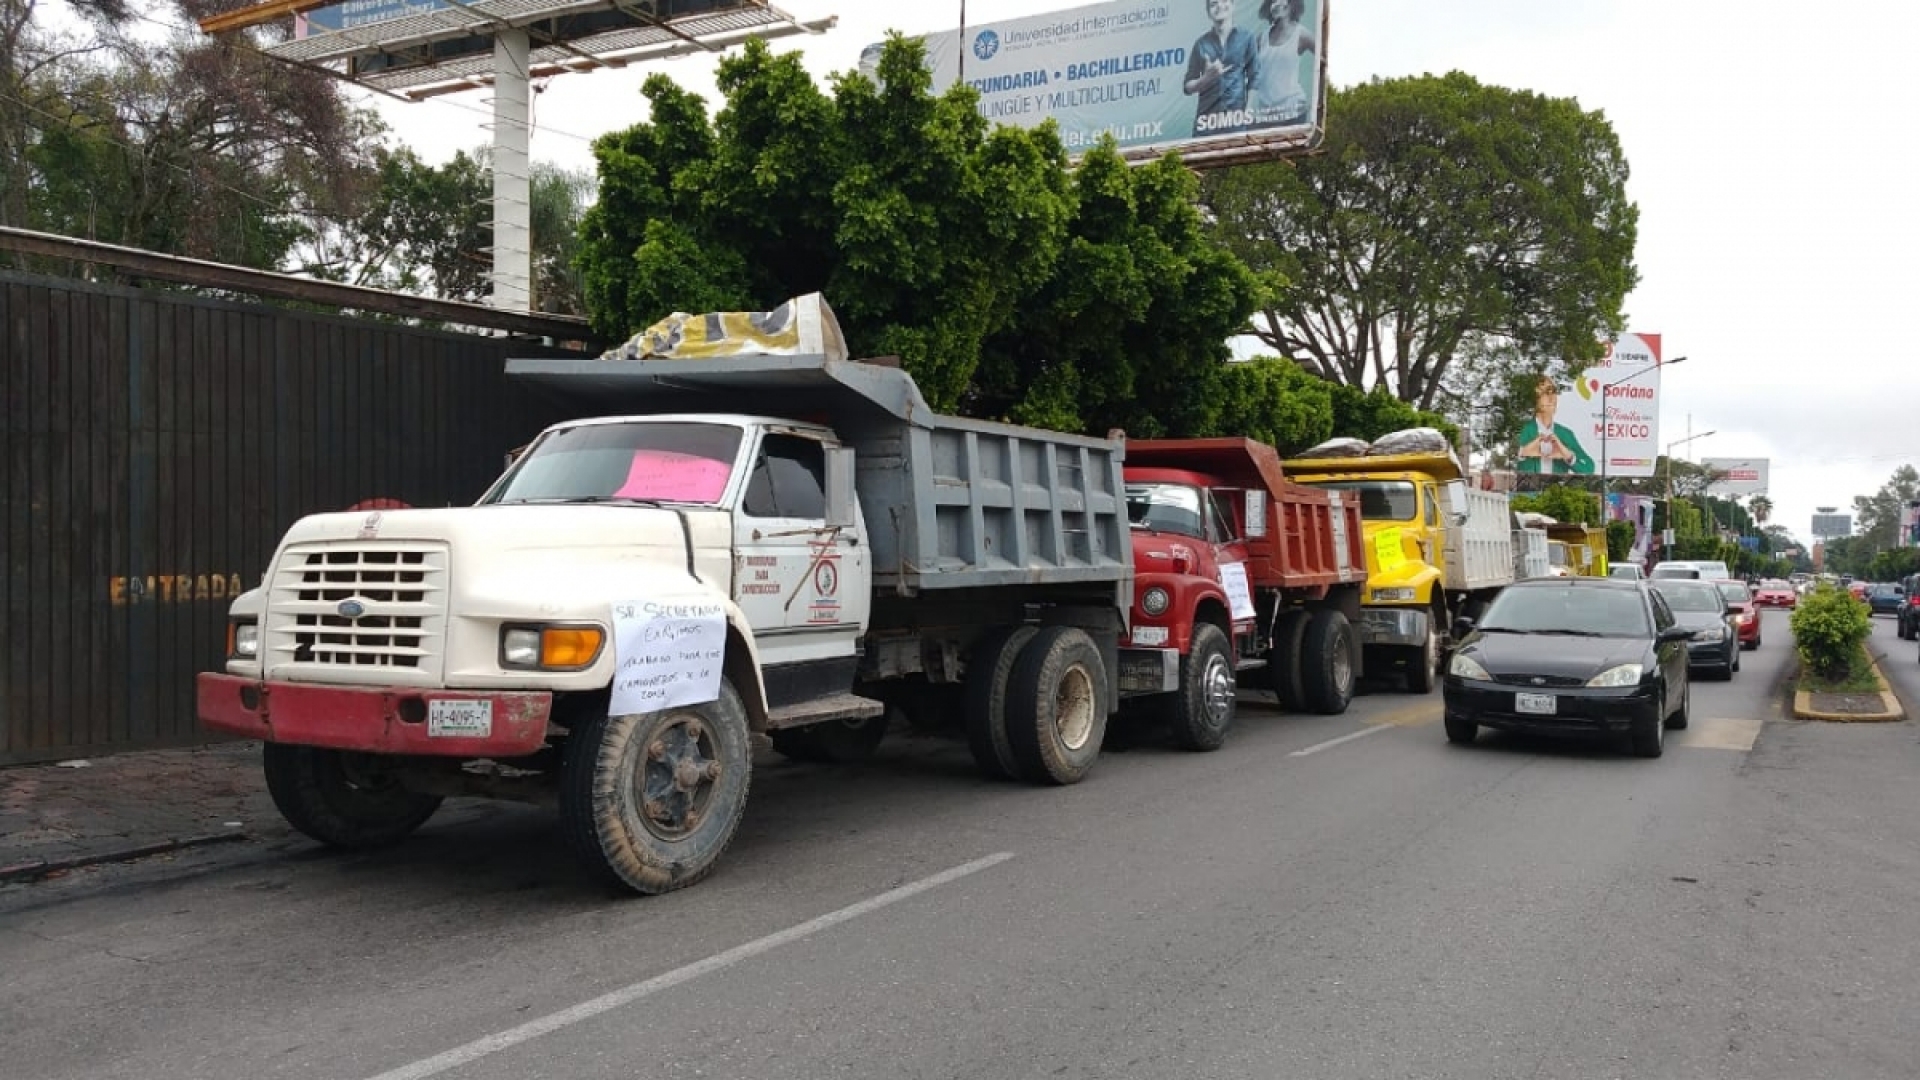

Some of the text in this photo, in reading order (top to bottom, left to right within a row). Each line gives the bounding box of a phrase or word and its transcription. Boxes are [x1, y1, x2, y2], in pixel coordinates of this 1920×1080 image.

[1004, 19, 1079, 44] Universidad
[1082, 4, 1169, 31] Internacional
[1067, 47, 1185, 81] BACHILLERATO
[980, 78, 1164, 117] ILINGÜE Y MULTICULTURAL
[1196, 108, 1254, 132] SOMOS
